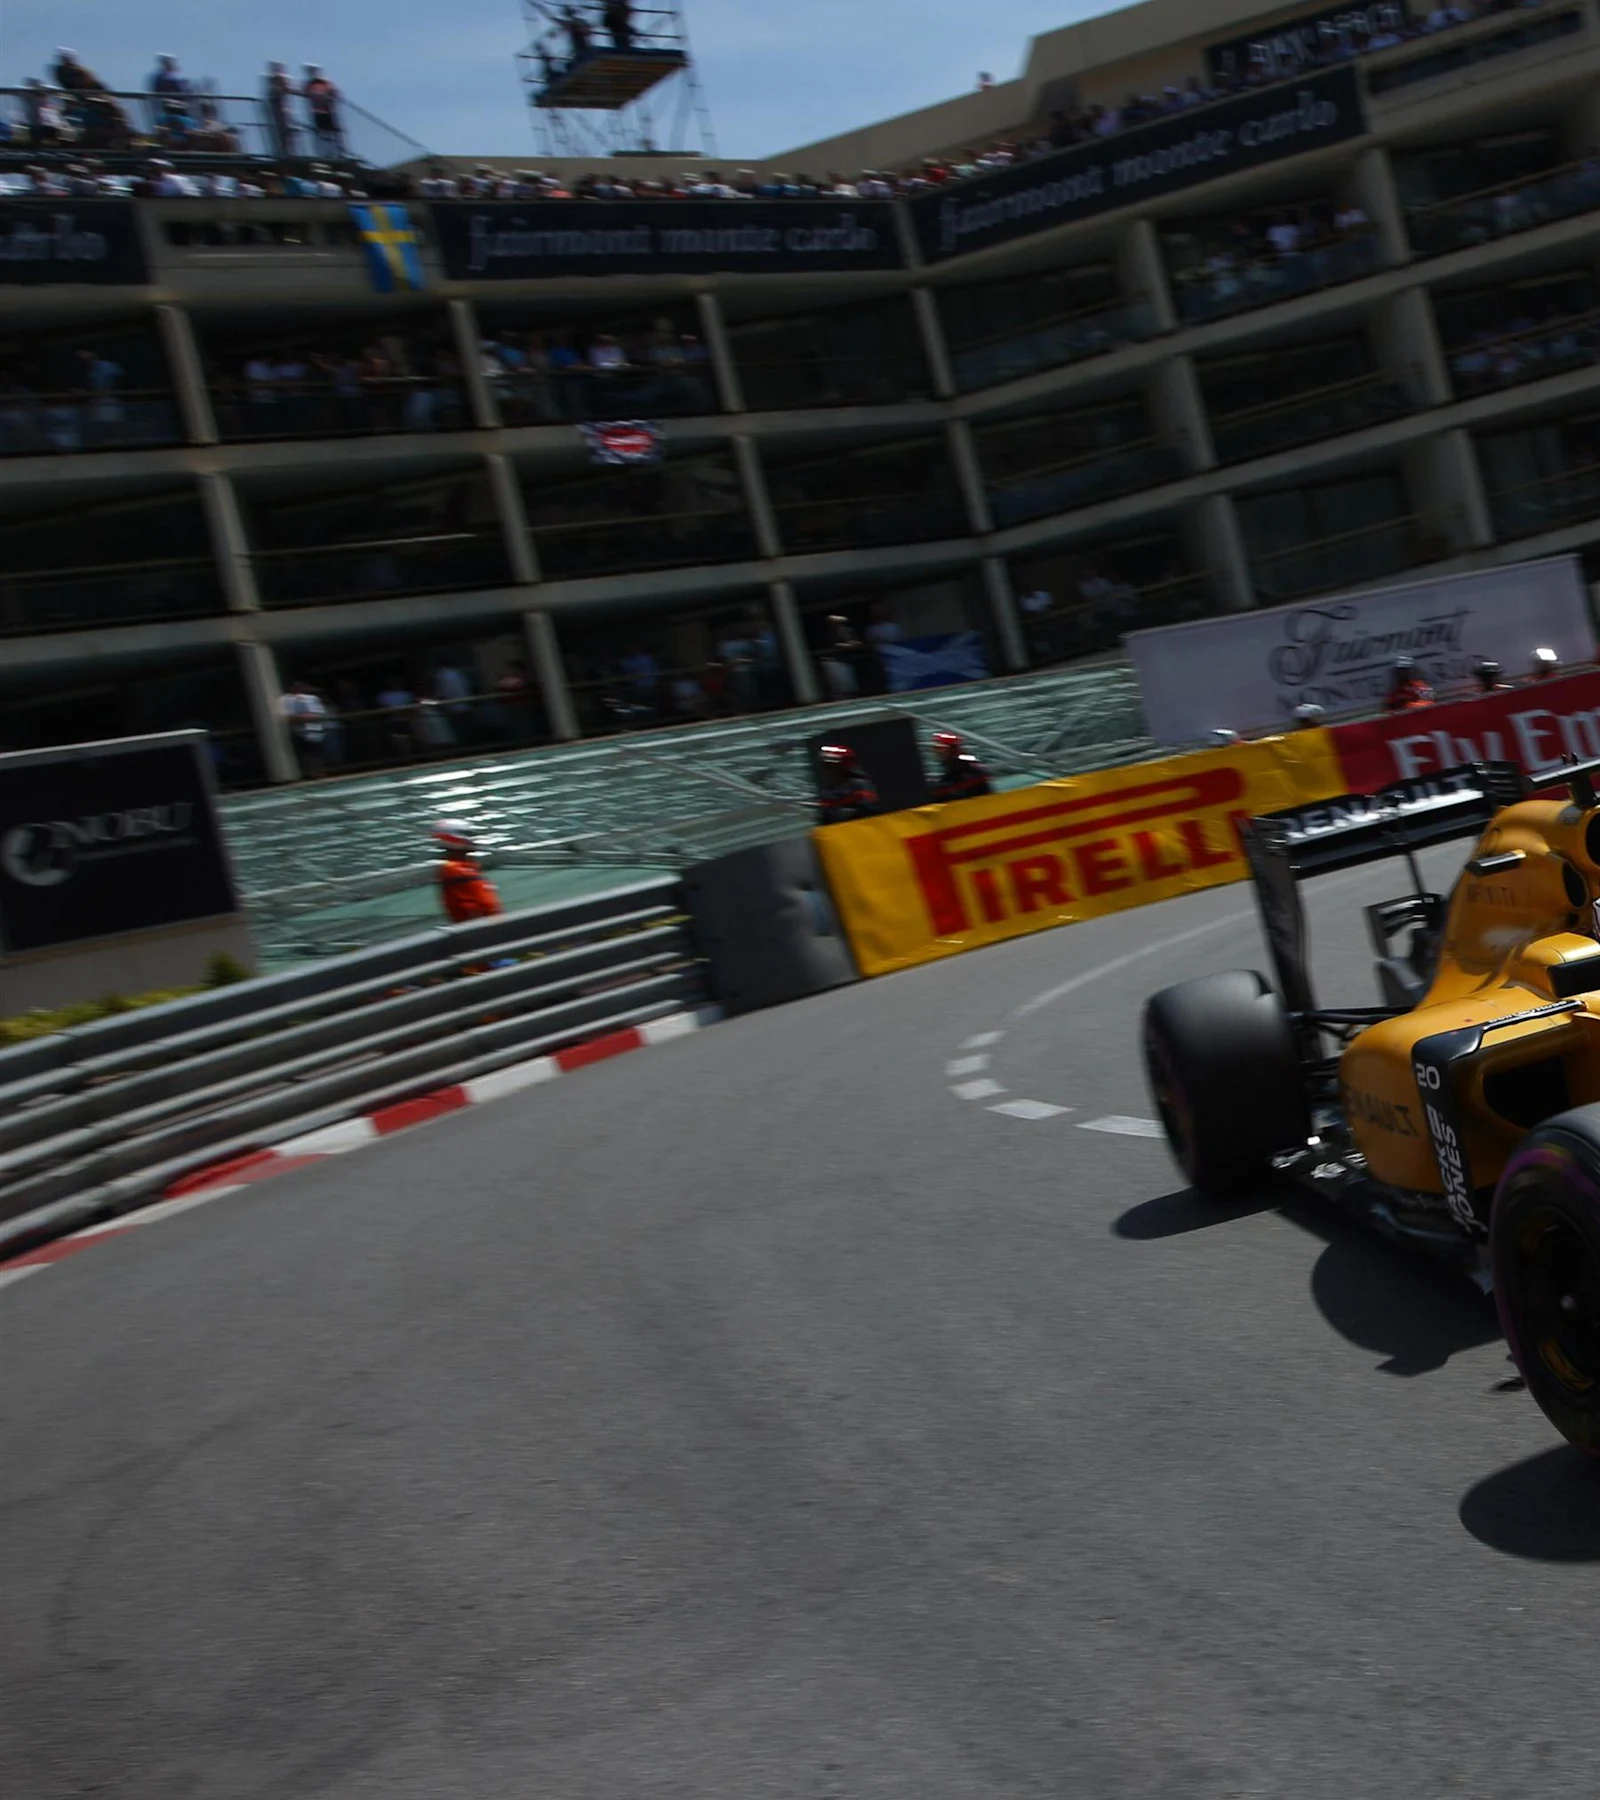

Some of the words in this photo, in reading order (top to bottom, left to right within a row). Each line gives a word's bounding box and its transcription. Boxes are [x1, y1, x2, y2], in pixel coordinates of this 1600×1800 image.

[1239, 91, 1339, 146] carlo
[1386, 728, 1506, 780] Fly
[1414, 1062, 1441, 1090] 20
